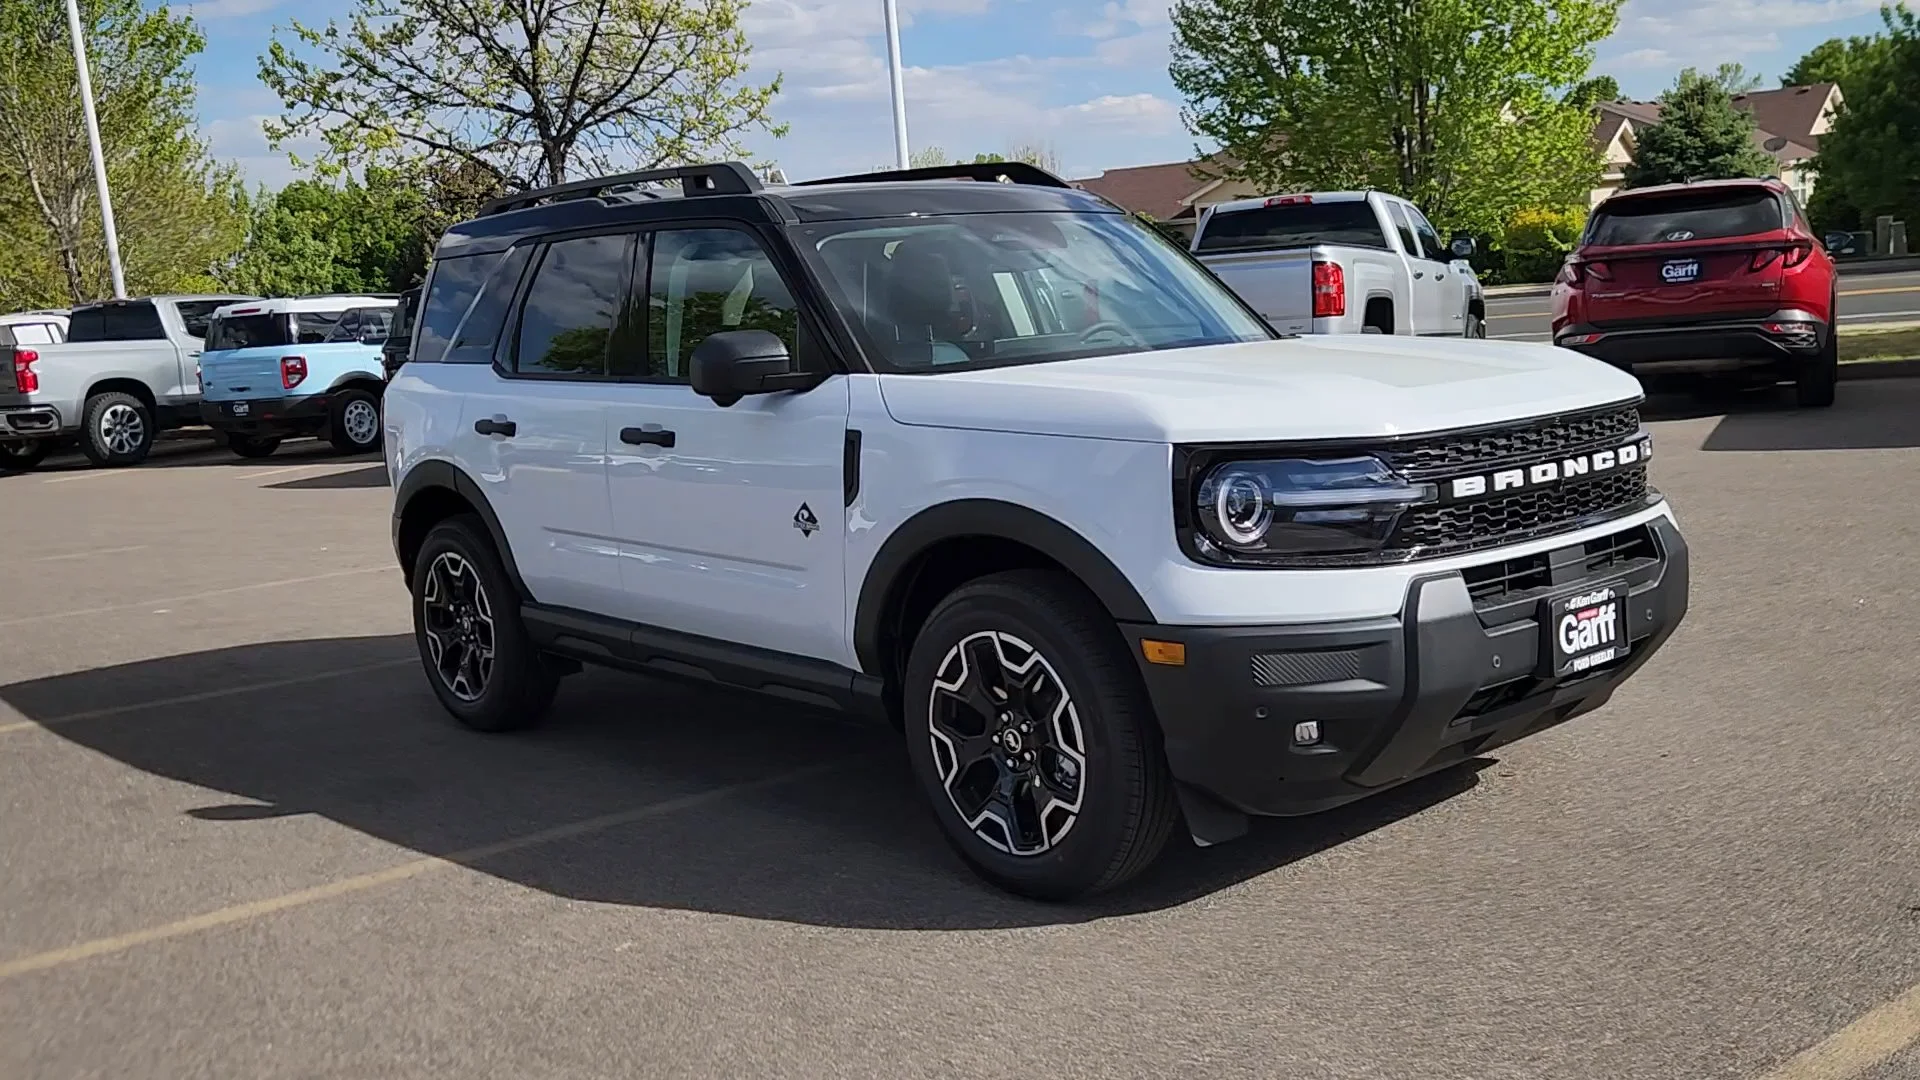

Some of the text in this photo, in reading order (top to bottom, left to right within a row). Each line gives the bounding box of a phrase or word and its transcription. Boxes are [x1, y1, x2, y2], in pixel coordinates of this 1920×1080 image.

[1662, 263, 1698, 278] Garff
[1452, 444, 1638, 498] BRONCO
[1559, 602, 1616, 654] Garff
